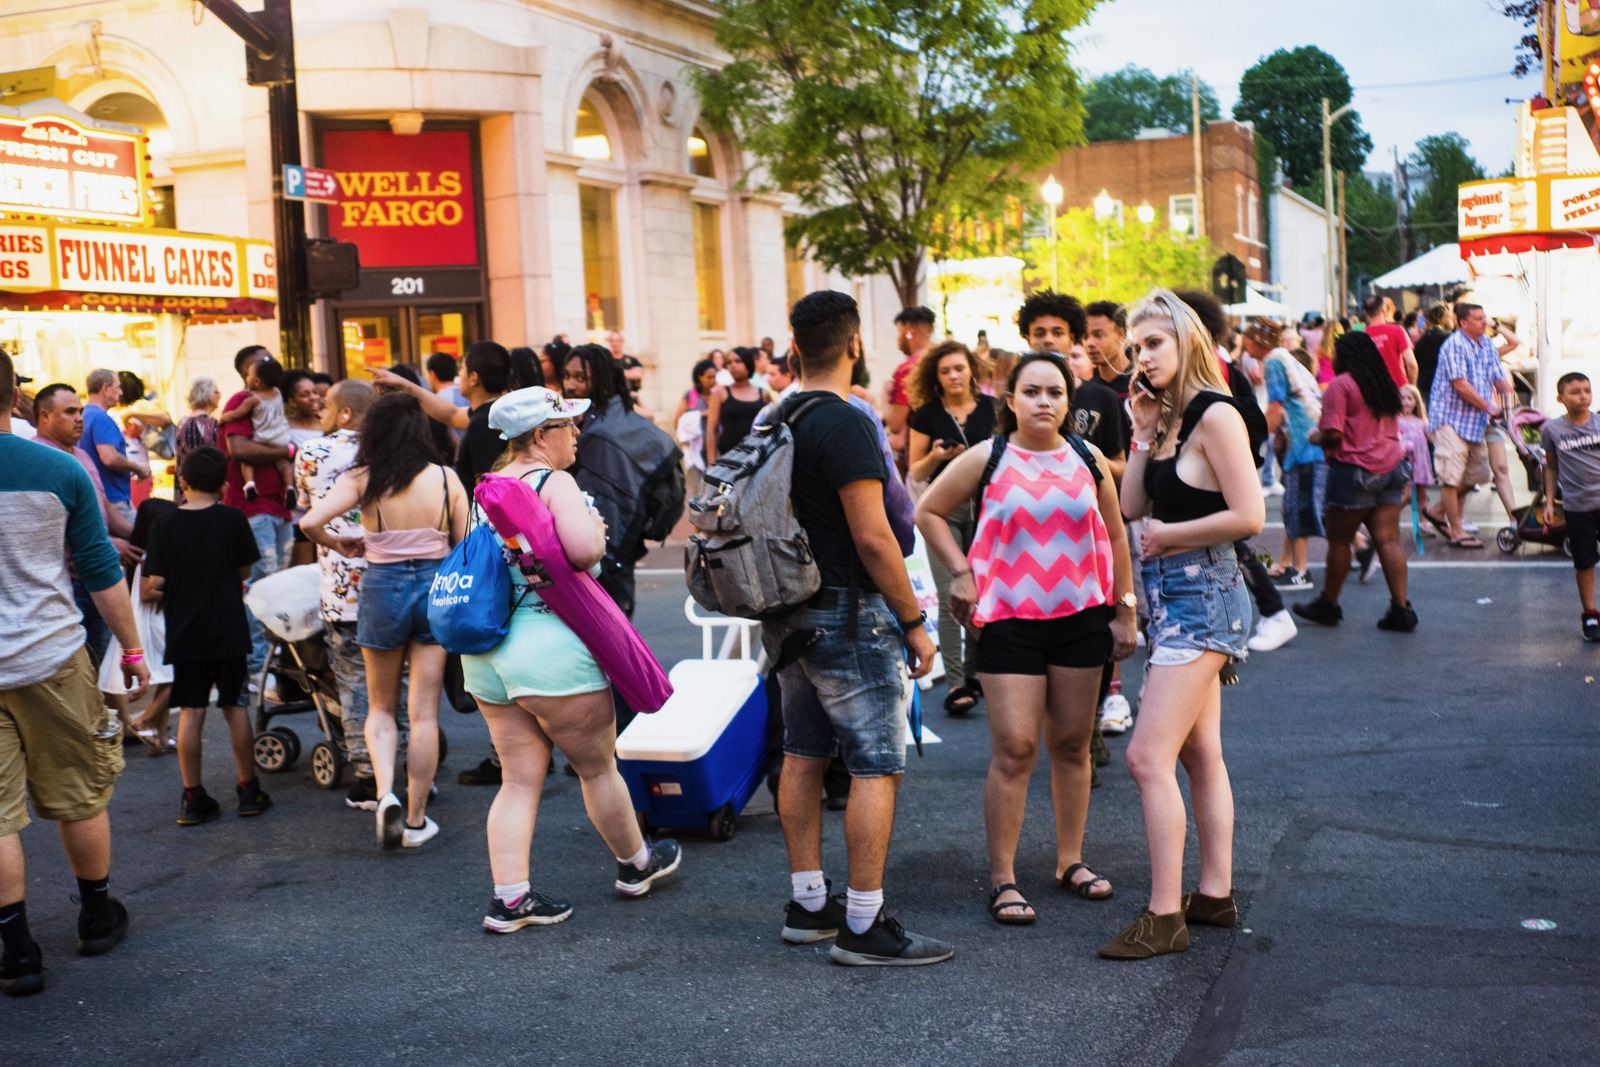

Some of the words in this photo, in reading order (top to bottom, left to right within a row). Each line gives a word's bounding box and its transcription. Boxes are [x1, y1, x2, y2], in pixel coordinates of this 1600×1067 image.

[72, 149, 118, 168] CUT
[287, 168, 302, 193] P
[335, 171, 462, 197] WELLS
[340, 200, 463, 227] FARGO
[59, 238, 156, 284] FUNNEL
[163, 246, 234, 288] CAKES
[391, 277, 424, 294] 201
[81, 292, 156, 307] CORN
[163, 296, 229, 309] DOGS
[1074, 408, 1101, 436] 87
